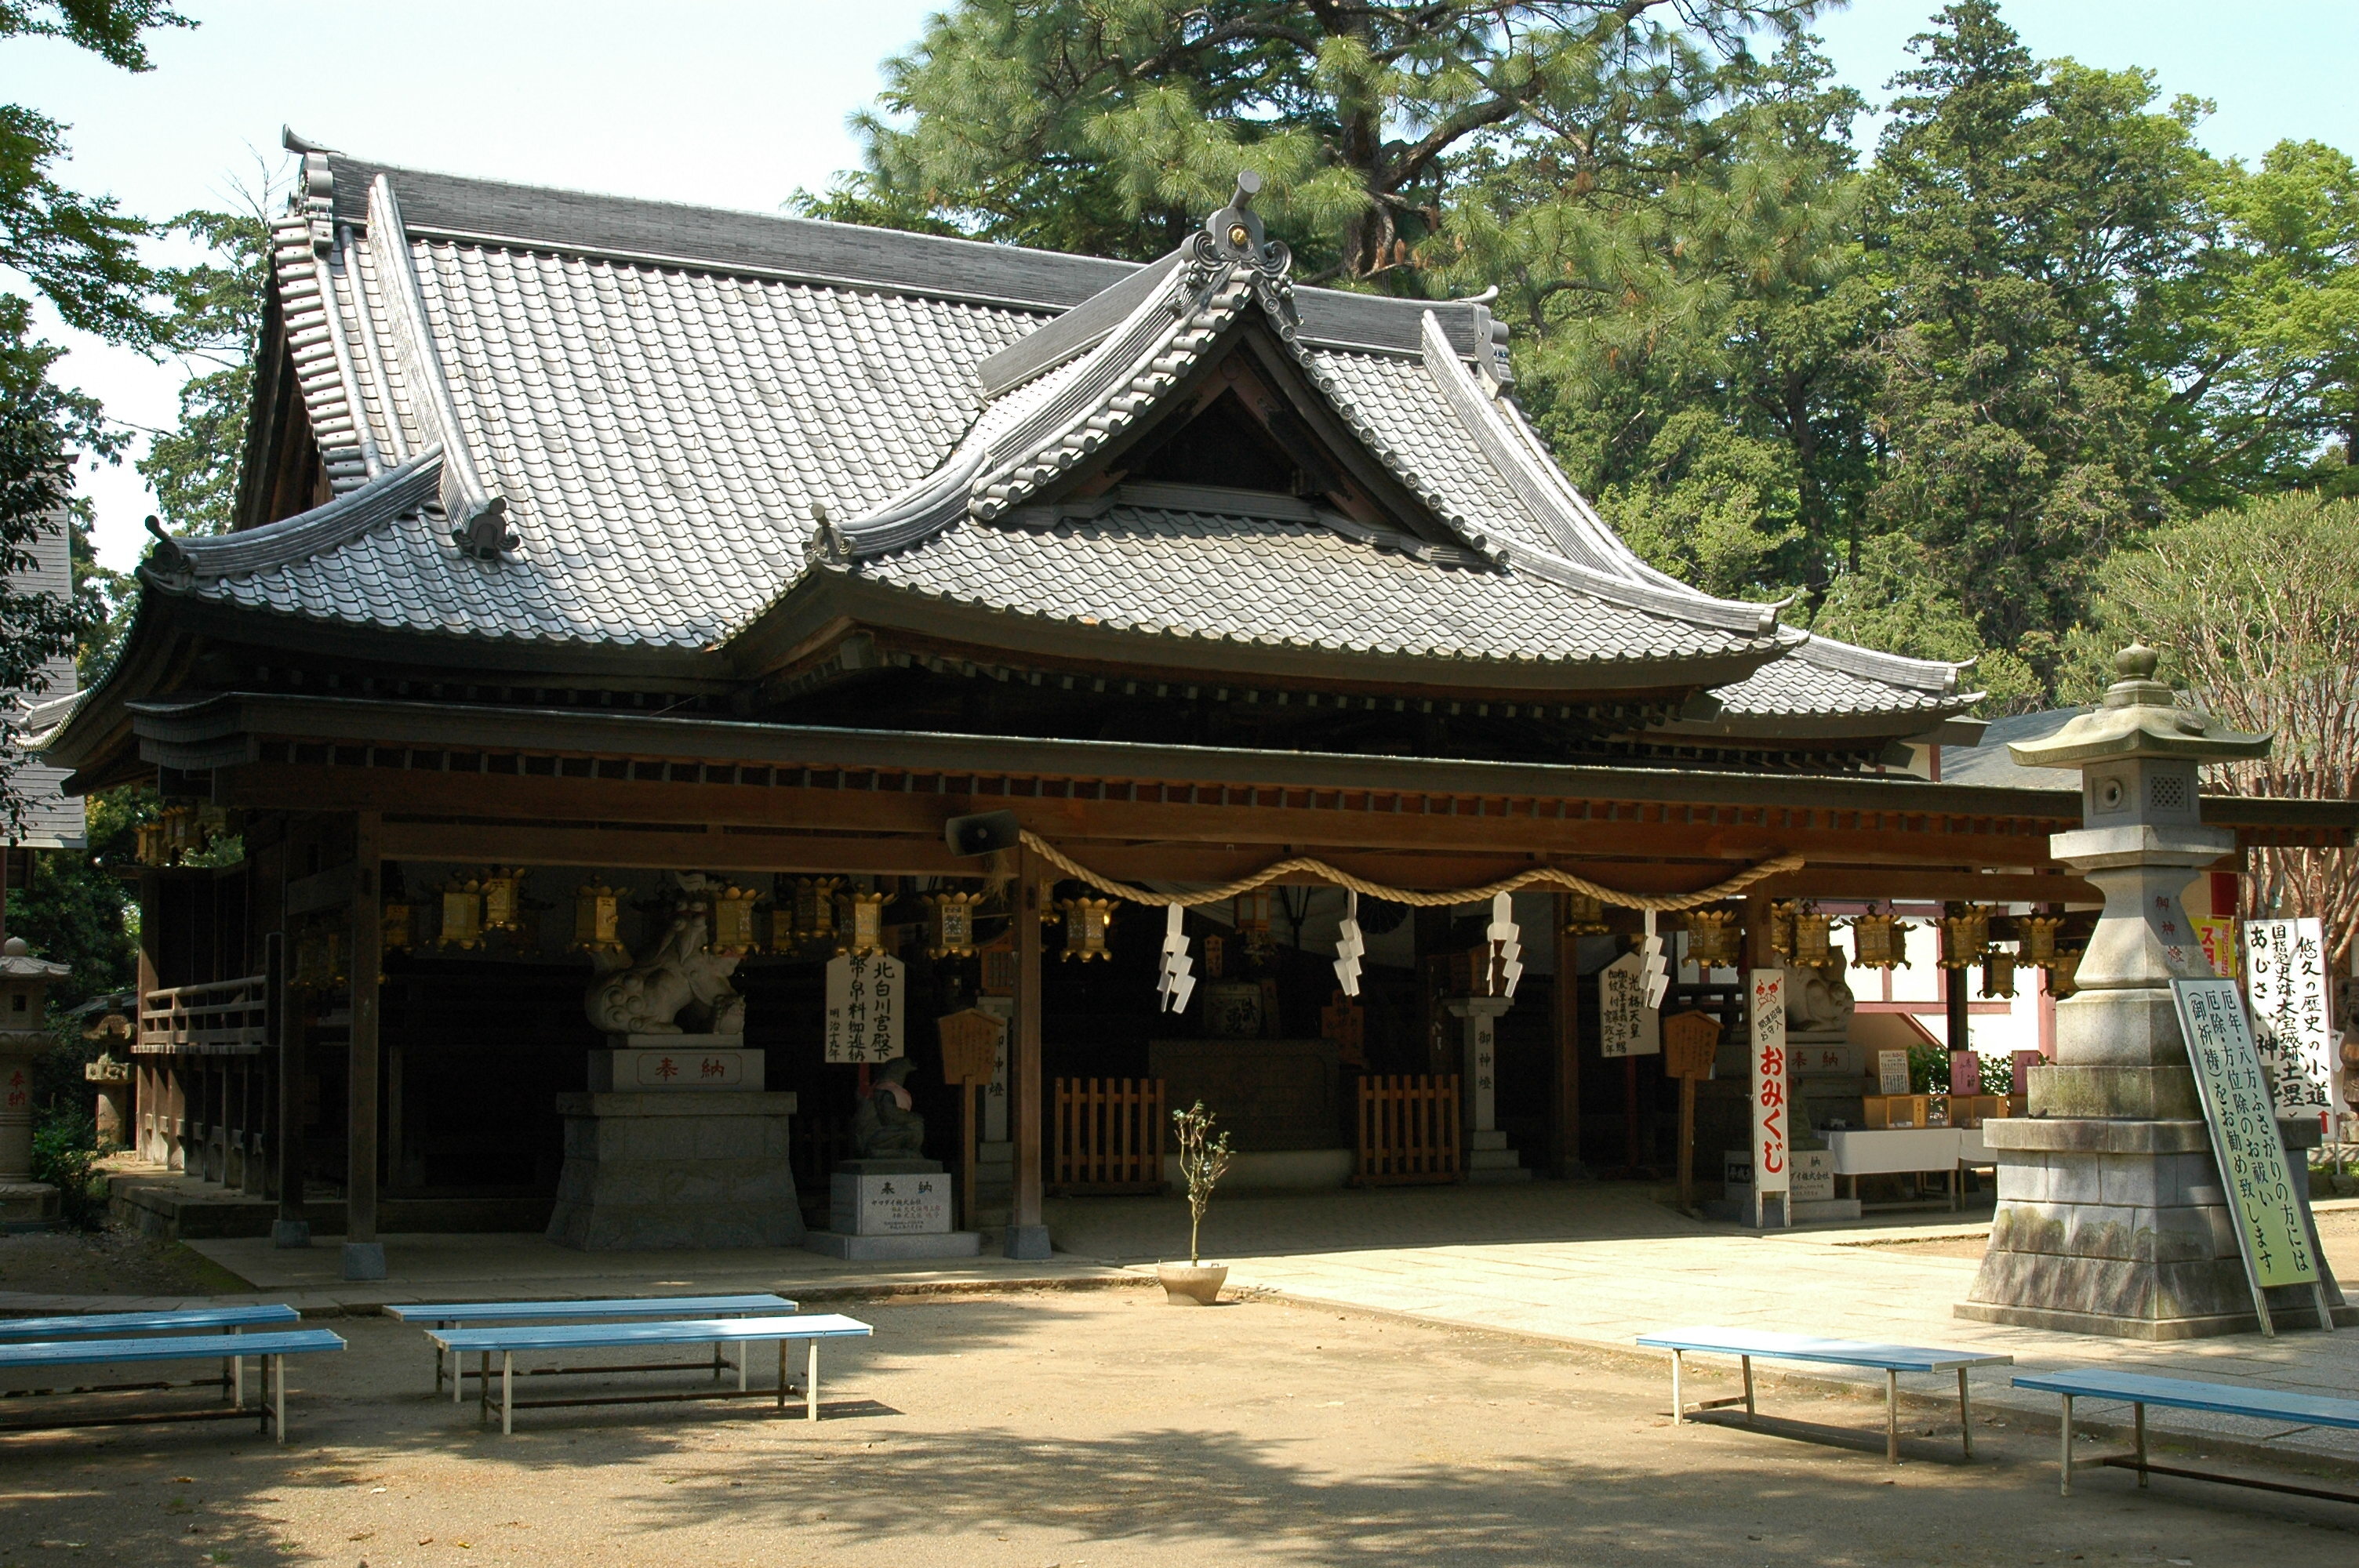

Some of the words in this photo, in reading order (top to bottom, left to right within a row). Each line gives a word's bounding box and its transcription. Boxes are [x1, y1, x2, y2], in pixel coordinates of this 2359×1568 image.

[828, 1008, 841, 1062] 明治十九年
[871, 962, 895, 1061] 北白川宮殿下
[1629, 974, 1641, 1040] 光格天皇
[2296, 936, 2332, 1107] 悠久の歴史の小道
[8, 1070, 27, 1107] 奉納
[654, 1057, 725, 1082] 奉納
[1791, 1051, 1839, 1069] 奉納
[1760, 1045, 1783, 1174] おみくじ
[2205, 989, 2273, 1207] 厄除・方位除のお祓い
[2221, 989, 2310, 1272] 厄年・八方ふさがりの方には
[880, 1181, 933, 1195] 奉納
